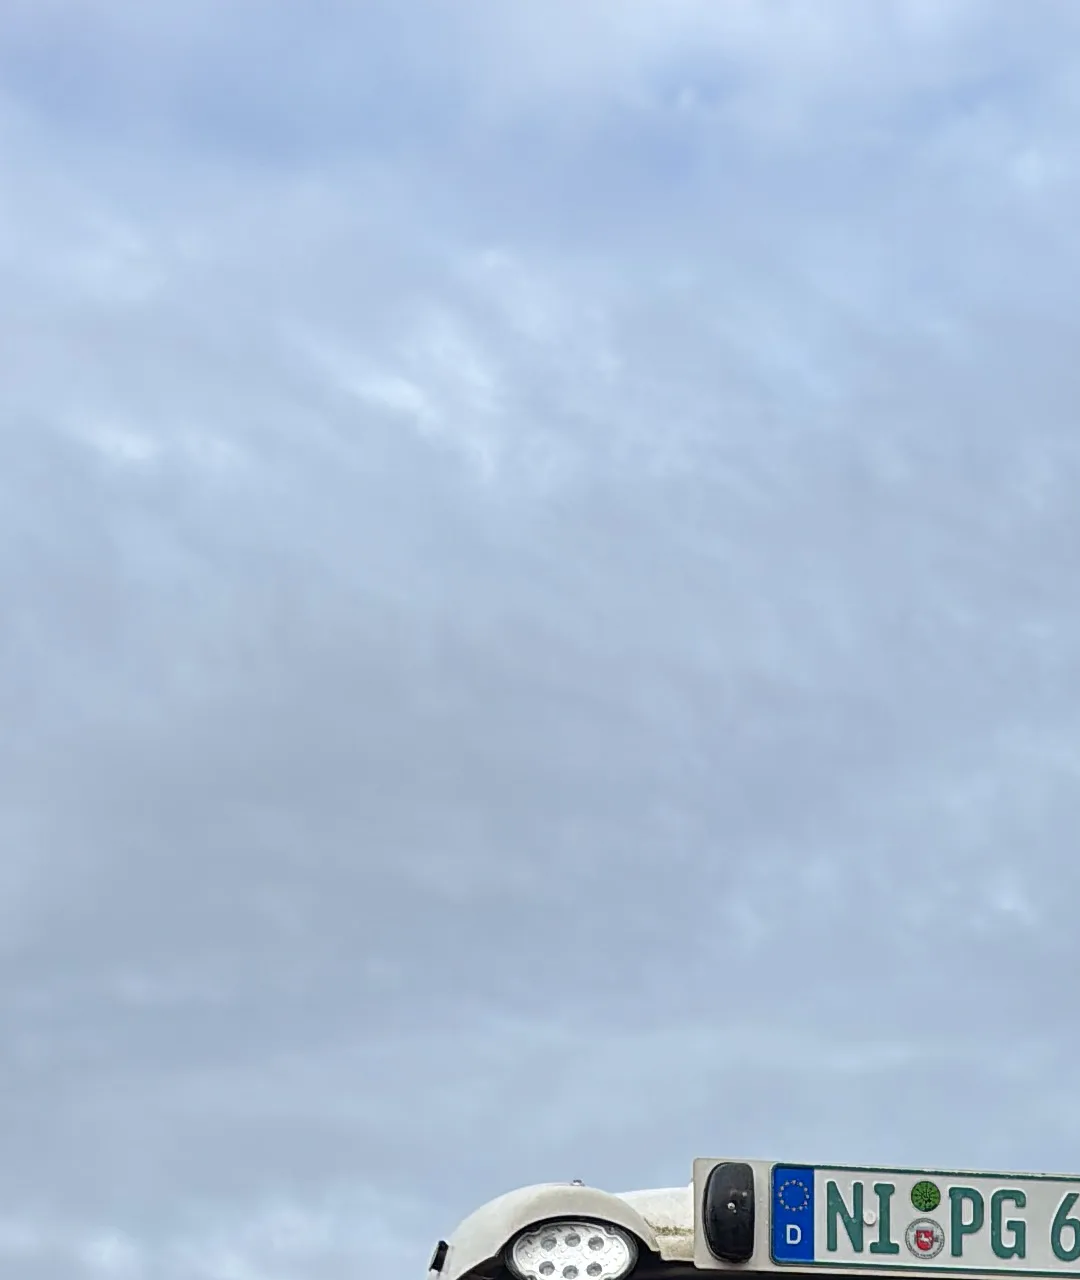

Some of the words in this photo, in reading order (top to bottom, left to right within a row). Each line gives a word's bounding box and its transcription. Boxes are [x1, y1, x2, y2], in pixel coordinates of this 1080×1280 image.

[786, 1224, 802, 1246] D
[826, 1180, 900, 1255] NI
[948, 1186, 1027, 1259] PG
